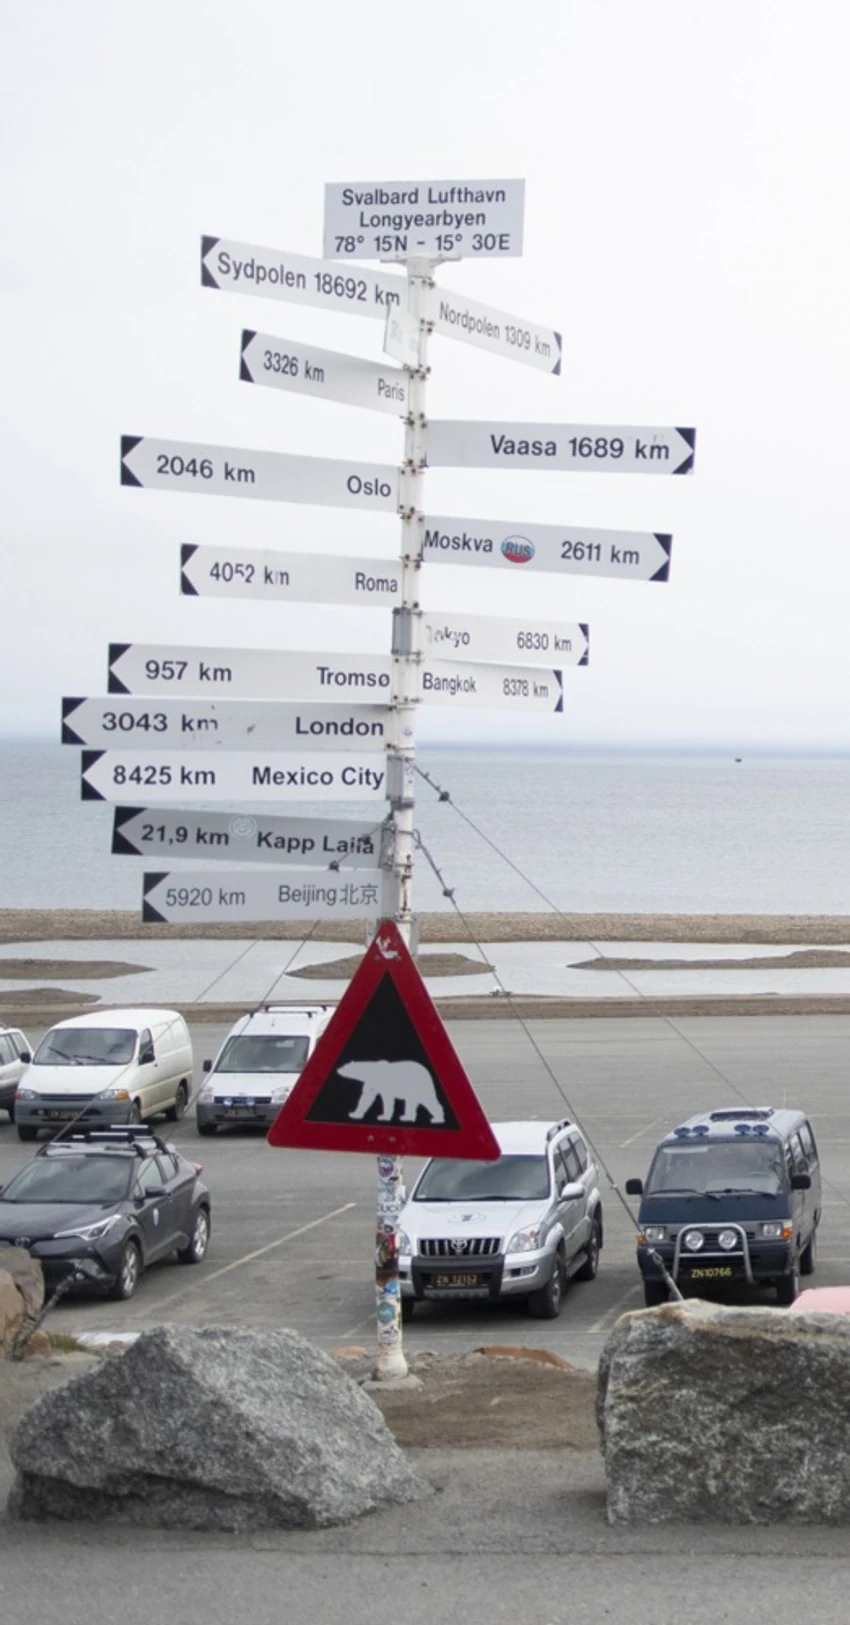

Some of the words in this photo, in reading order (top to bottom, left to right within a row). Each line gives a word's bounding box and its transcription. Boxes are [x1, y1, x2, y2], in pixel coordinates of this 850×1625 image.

[342, 188, 418, 206] Svalbard
[427, 187, 506, 204] Lufthavn
[359, 210, 486, 231] Longyearbyen
[335, 235, 364, 253] 78°
[374, 235, 407, 252] 15N
[436, 233, 463, 251] 15°
[471, 233, 511, 251] 30E
[217, 252, 306, 289] Sydpolen
[314, 273, 367, 302] 18692
[375, 285, 400, 306] km
[440, 301, 500, 341] Nordpolen
[505, 326, 531, 350] 1309
[535, 336, 551, 357] km
[263, 350, 299, 376] 3326
[304, 360, 325, 382] km
[377, 377, 405, 402] Paris
[490, 435, 557, 456] Vaasa
[568, 437, 624, 458] 1689
[635, 439, 670, 459] km
[157, 455, 213, 479] 2046
[224, 462, 255, 483] km
[347, 475, 391, 497] Oslo
[424, 530, 493, 553] Moskva
[560, 541, 602, 562] 2611
[610, 545, 640, 564] km
[505, 540, 532, 556] RUS
[210, 562, 255, 583] 4052
[264, 566, 290, 585] km
[355, 572, 398, 592] Roma
[516, 632, 549, 650] 6830
[554, 635, 572, 651] km
[146, 660, 188, 681] 957
[199, 663, 232, 682] km
[316, 667, 390, 687] Tromsø
[422, 672, 476, 696] Bangkok
[503, 678, 529, 697] 8378
[533, 681, 549, 697] km
[102, 712, 168, 732] 3043
[181, 714, 218, 732] km
[295, 716, 384, 736] London
[113, 766, 172, 785] 8425
[180, 766, 216, 785] km
[252, 767, 333, 786] Mexico
[341, 767, 385, 790] City
[141, 824, 188, 844] 21,9
[196, 827, 230, 846] km
[256, 831, 315, 853] Kapp
[166, 888, 213, 907] 5920
[219, 887, 246, 906] km
[278, 885, 336, 906] Beijing
[340, 883, 379, 906] 北京
